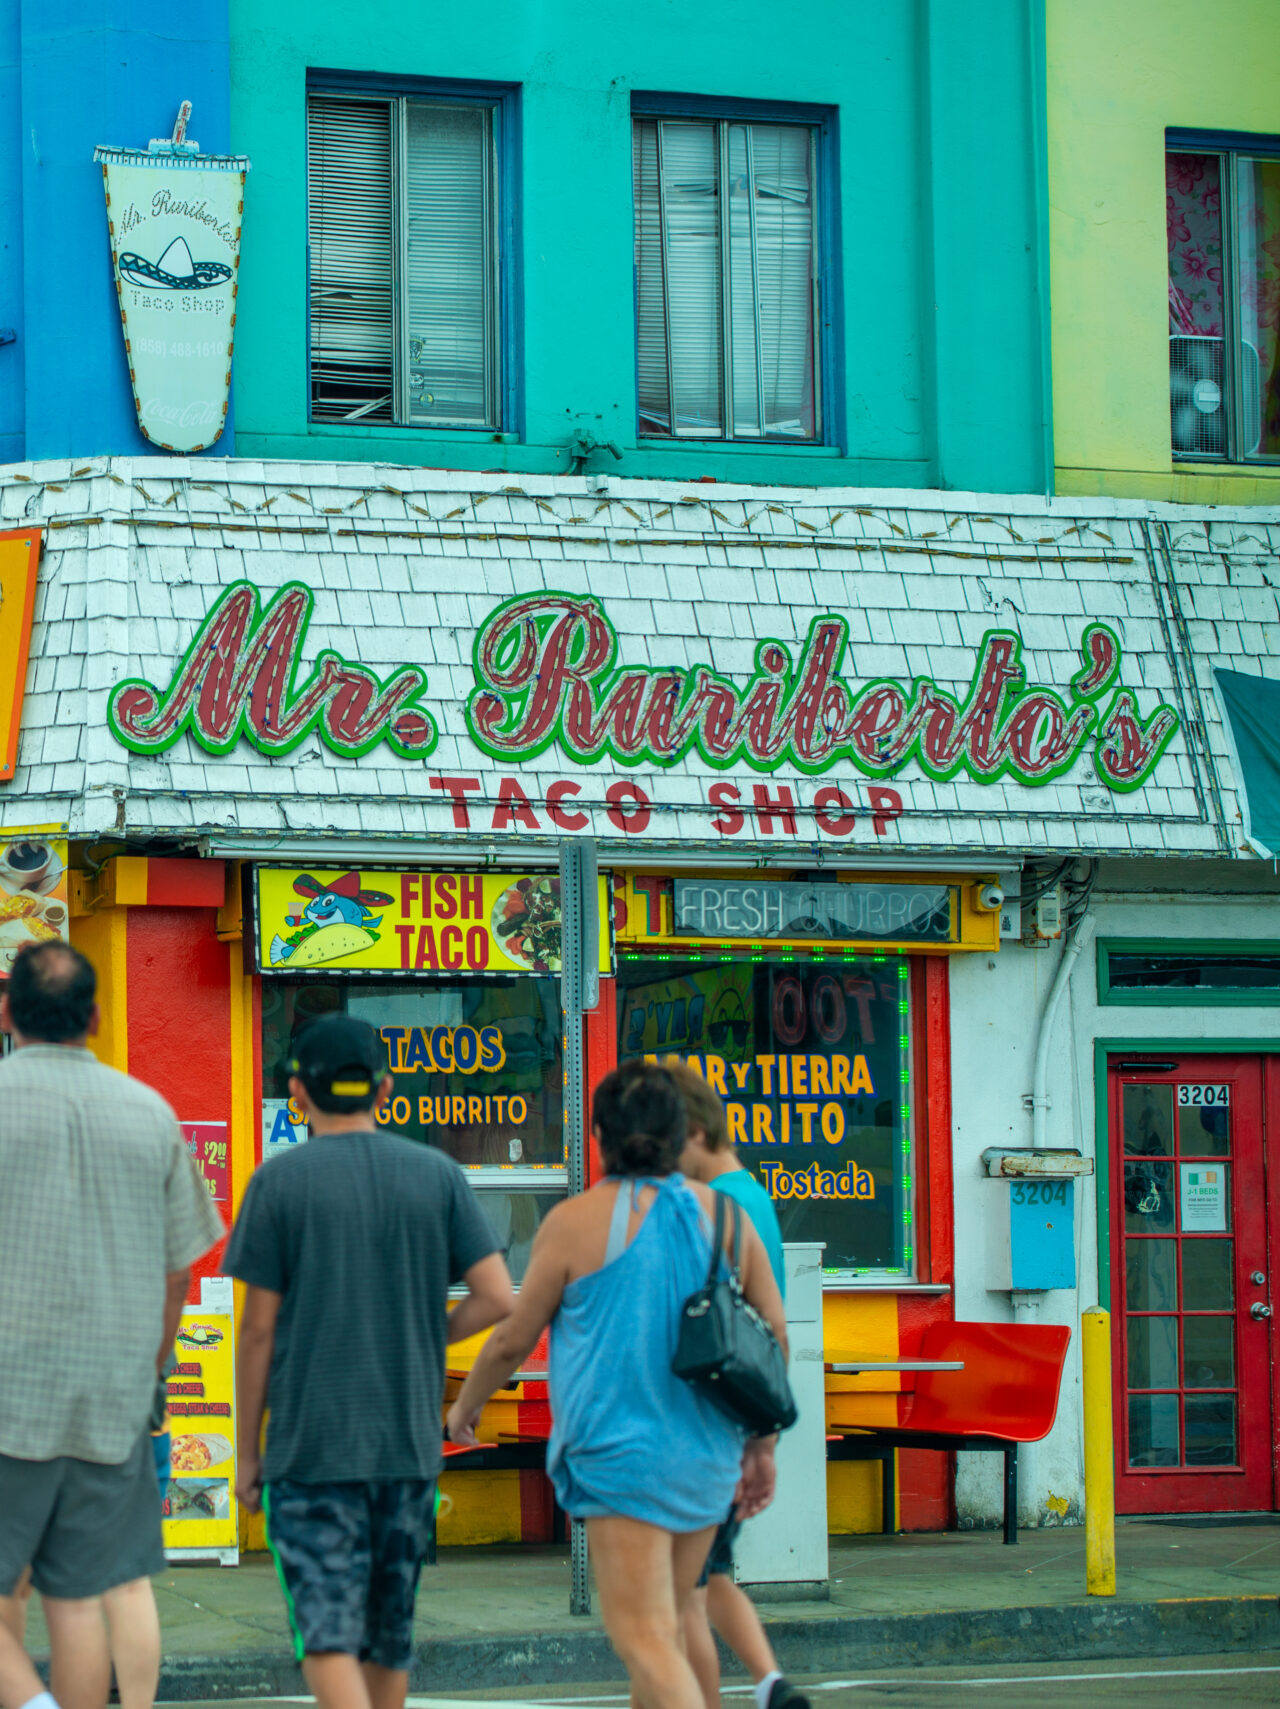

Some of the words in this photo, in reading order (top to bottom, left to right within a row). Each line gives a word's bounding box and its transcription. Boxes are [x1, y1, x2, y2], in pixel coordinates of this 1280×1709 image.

[130, 290, 174, 312] Taco
[182, 295, 225, 315] Shop
[108, 579, 439, 760] Mr.
[466, 588, 1180, 794] Ruriberto's
[429, 776, 651, 834] TACO
[707, 781, 905, 837] SHOP
[400, 873, 484, 920] FISH
[681, 886, 784, 932] FRESH
[798, 889, 952, 934] CHURROS
[395, 924, 490, 971] TACO
[380, 1025, 506, 1075] TACOS
[754, 1054, 878, 1099] TIERRA
[1179, 1085, 1228, 1106] 3204
[269, 1108, 298, 1143] A
[418, 1095, 528, 1126] BURRITO
[724, 1102, 848, 1147] RRITO
[760, 1160, 875, 1200] Tostada
[1012, 1182, 1068, 1207] 3204
[1199, 1187, 1219, 1196] BEDS
